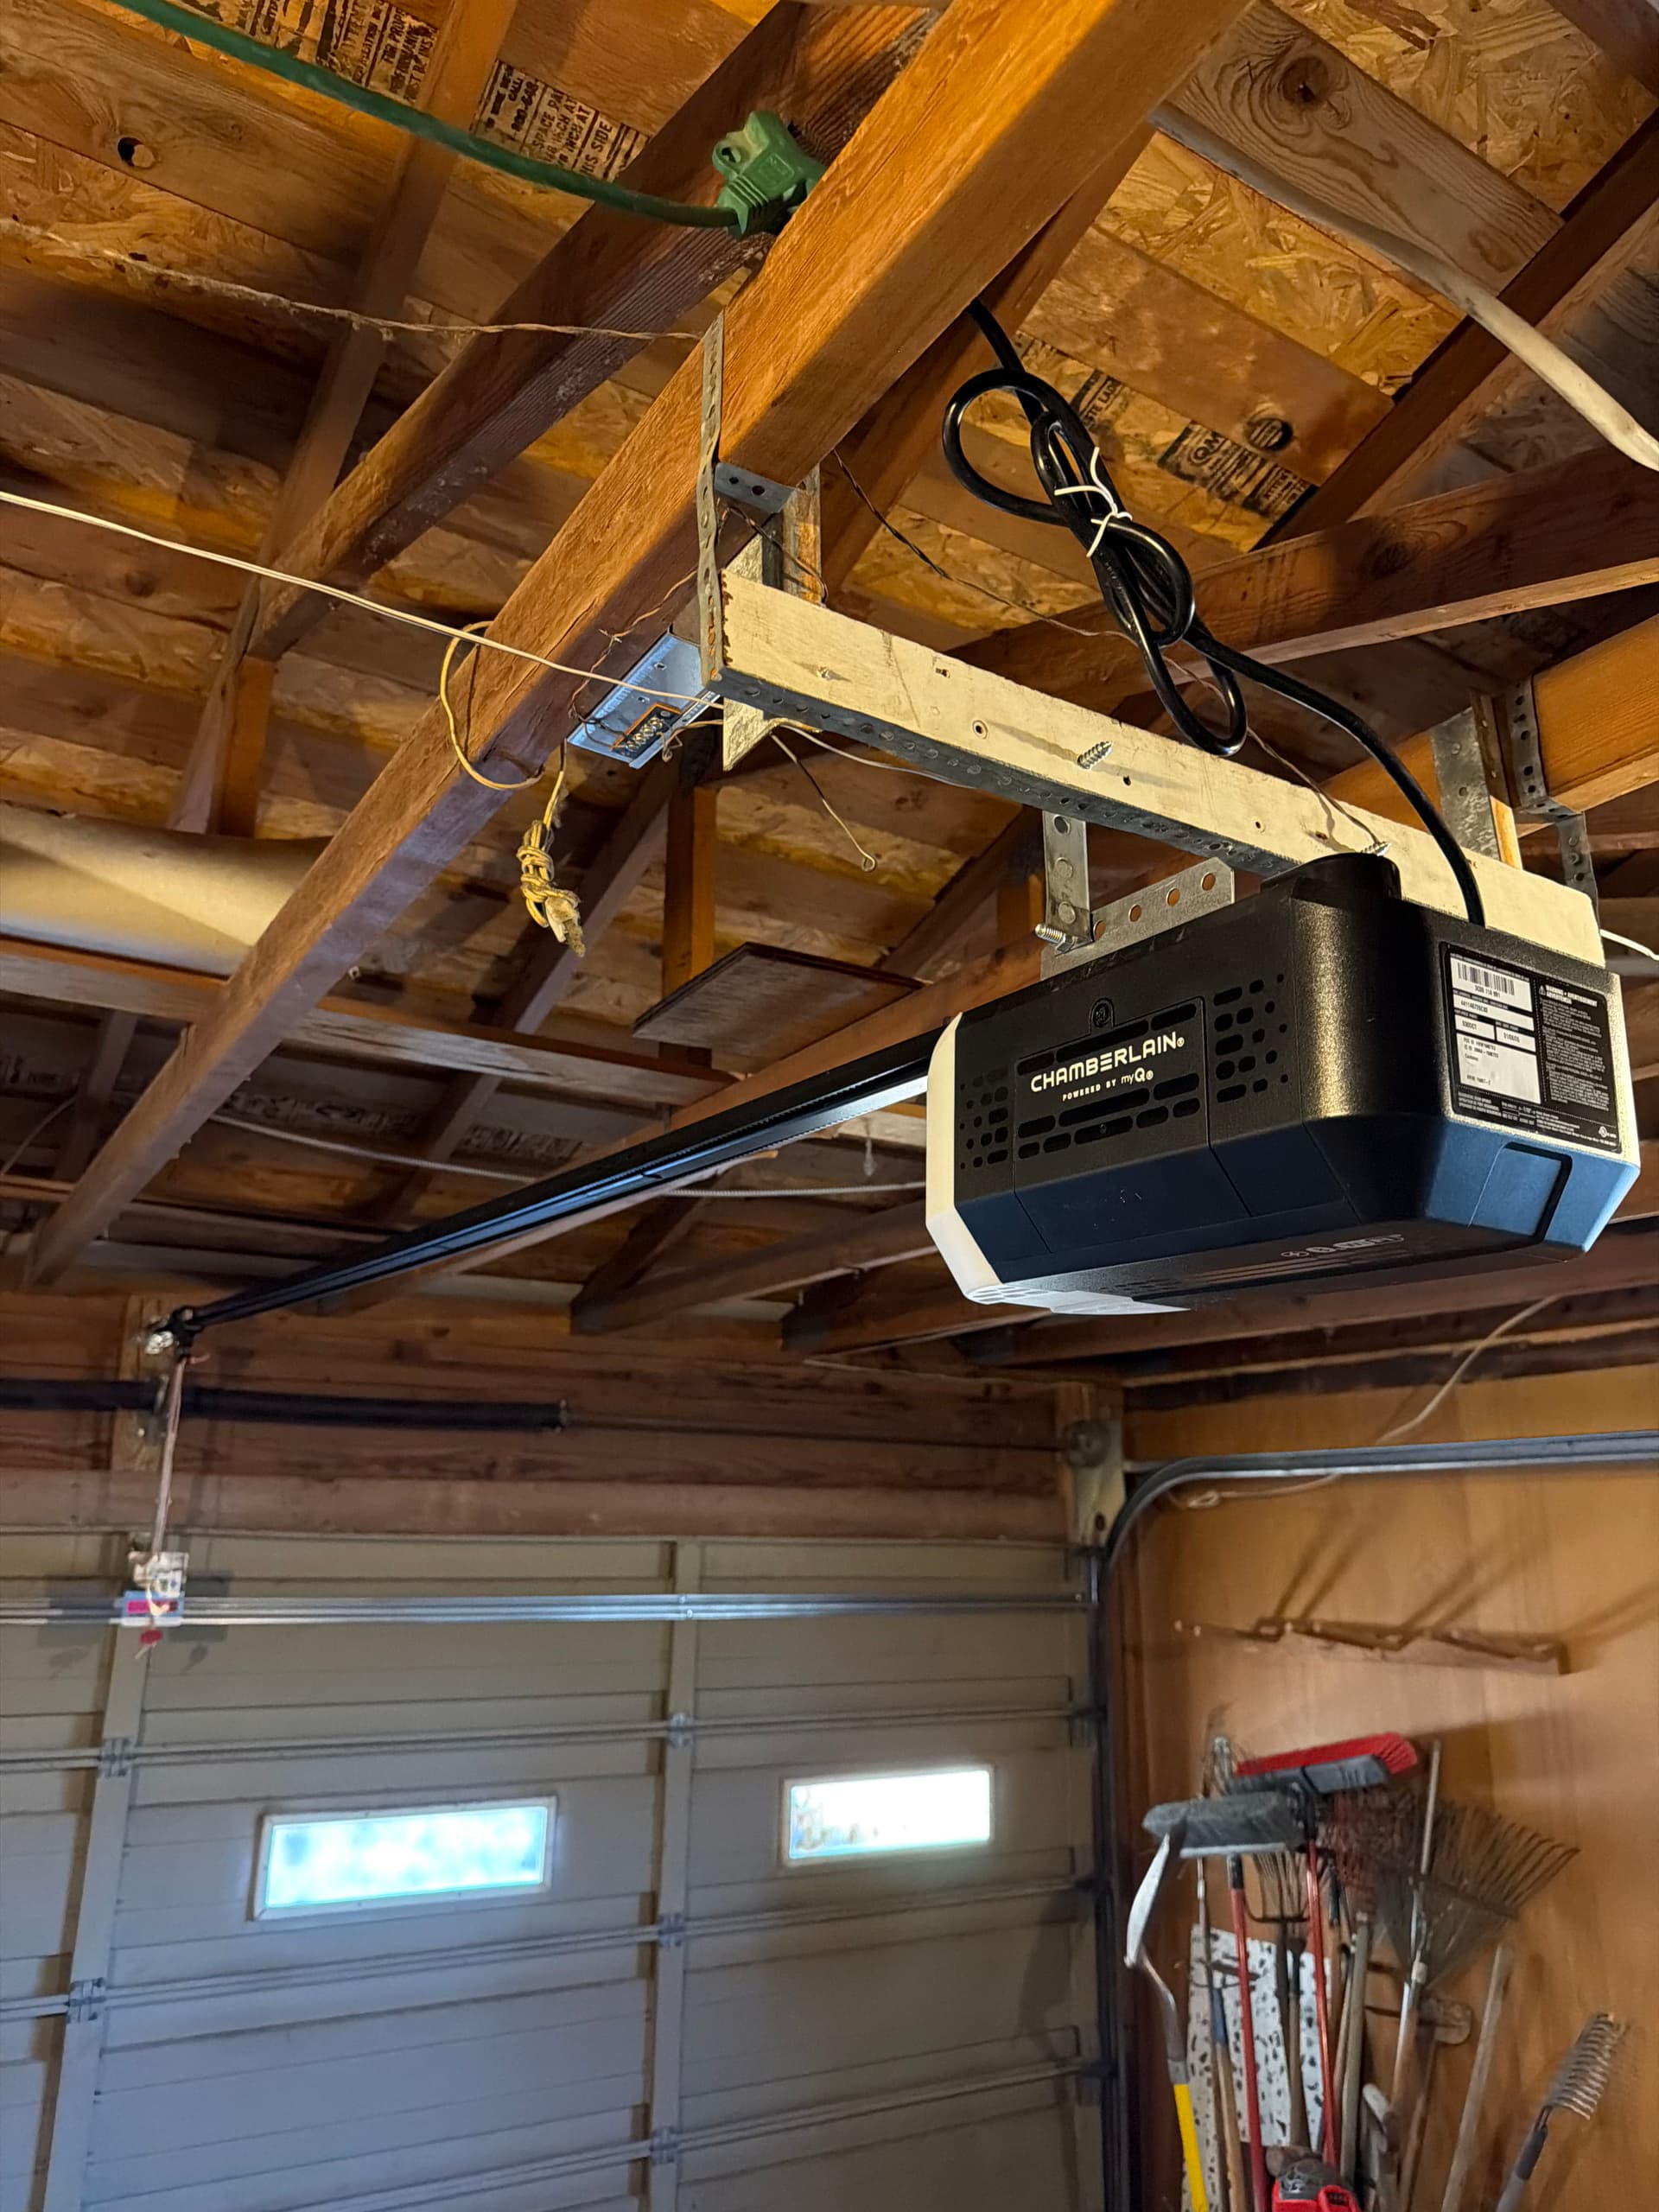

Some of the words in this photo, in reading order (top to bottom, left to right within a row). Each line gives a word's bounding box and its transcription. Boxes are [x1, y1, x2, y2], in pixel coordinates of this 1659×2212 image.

[531, 111, 556, 150] SPACE
[579, 105, 592, 128] AT
[591, 119, 613, 153] SIDE
[1062, 1084, 1102, 1102] POWERED
[1106, 1078, 1117, 1090] BY
